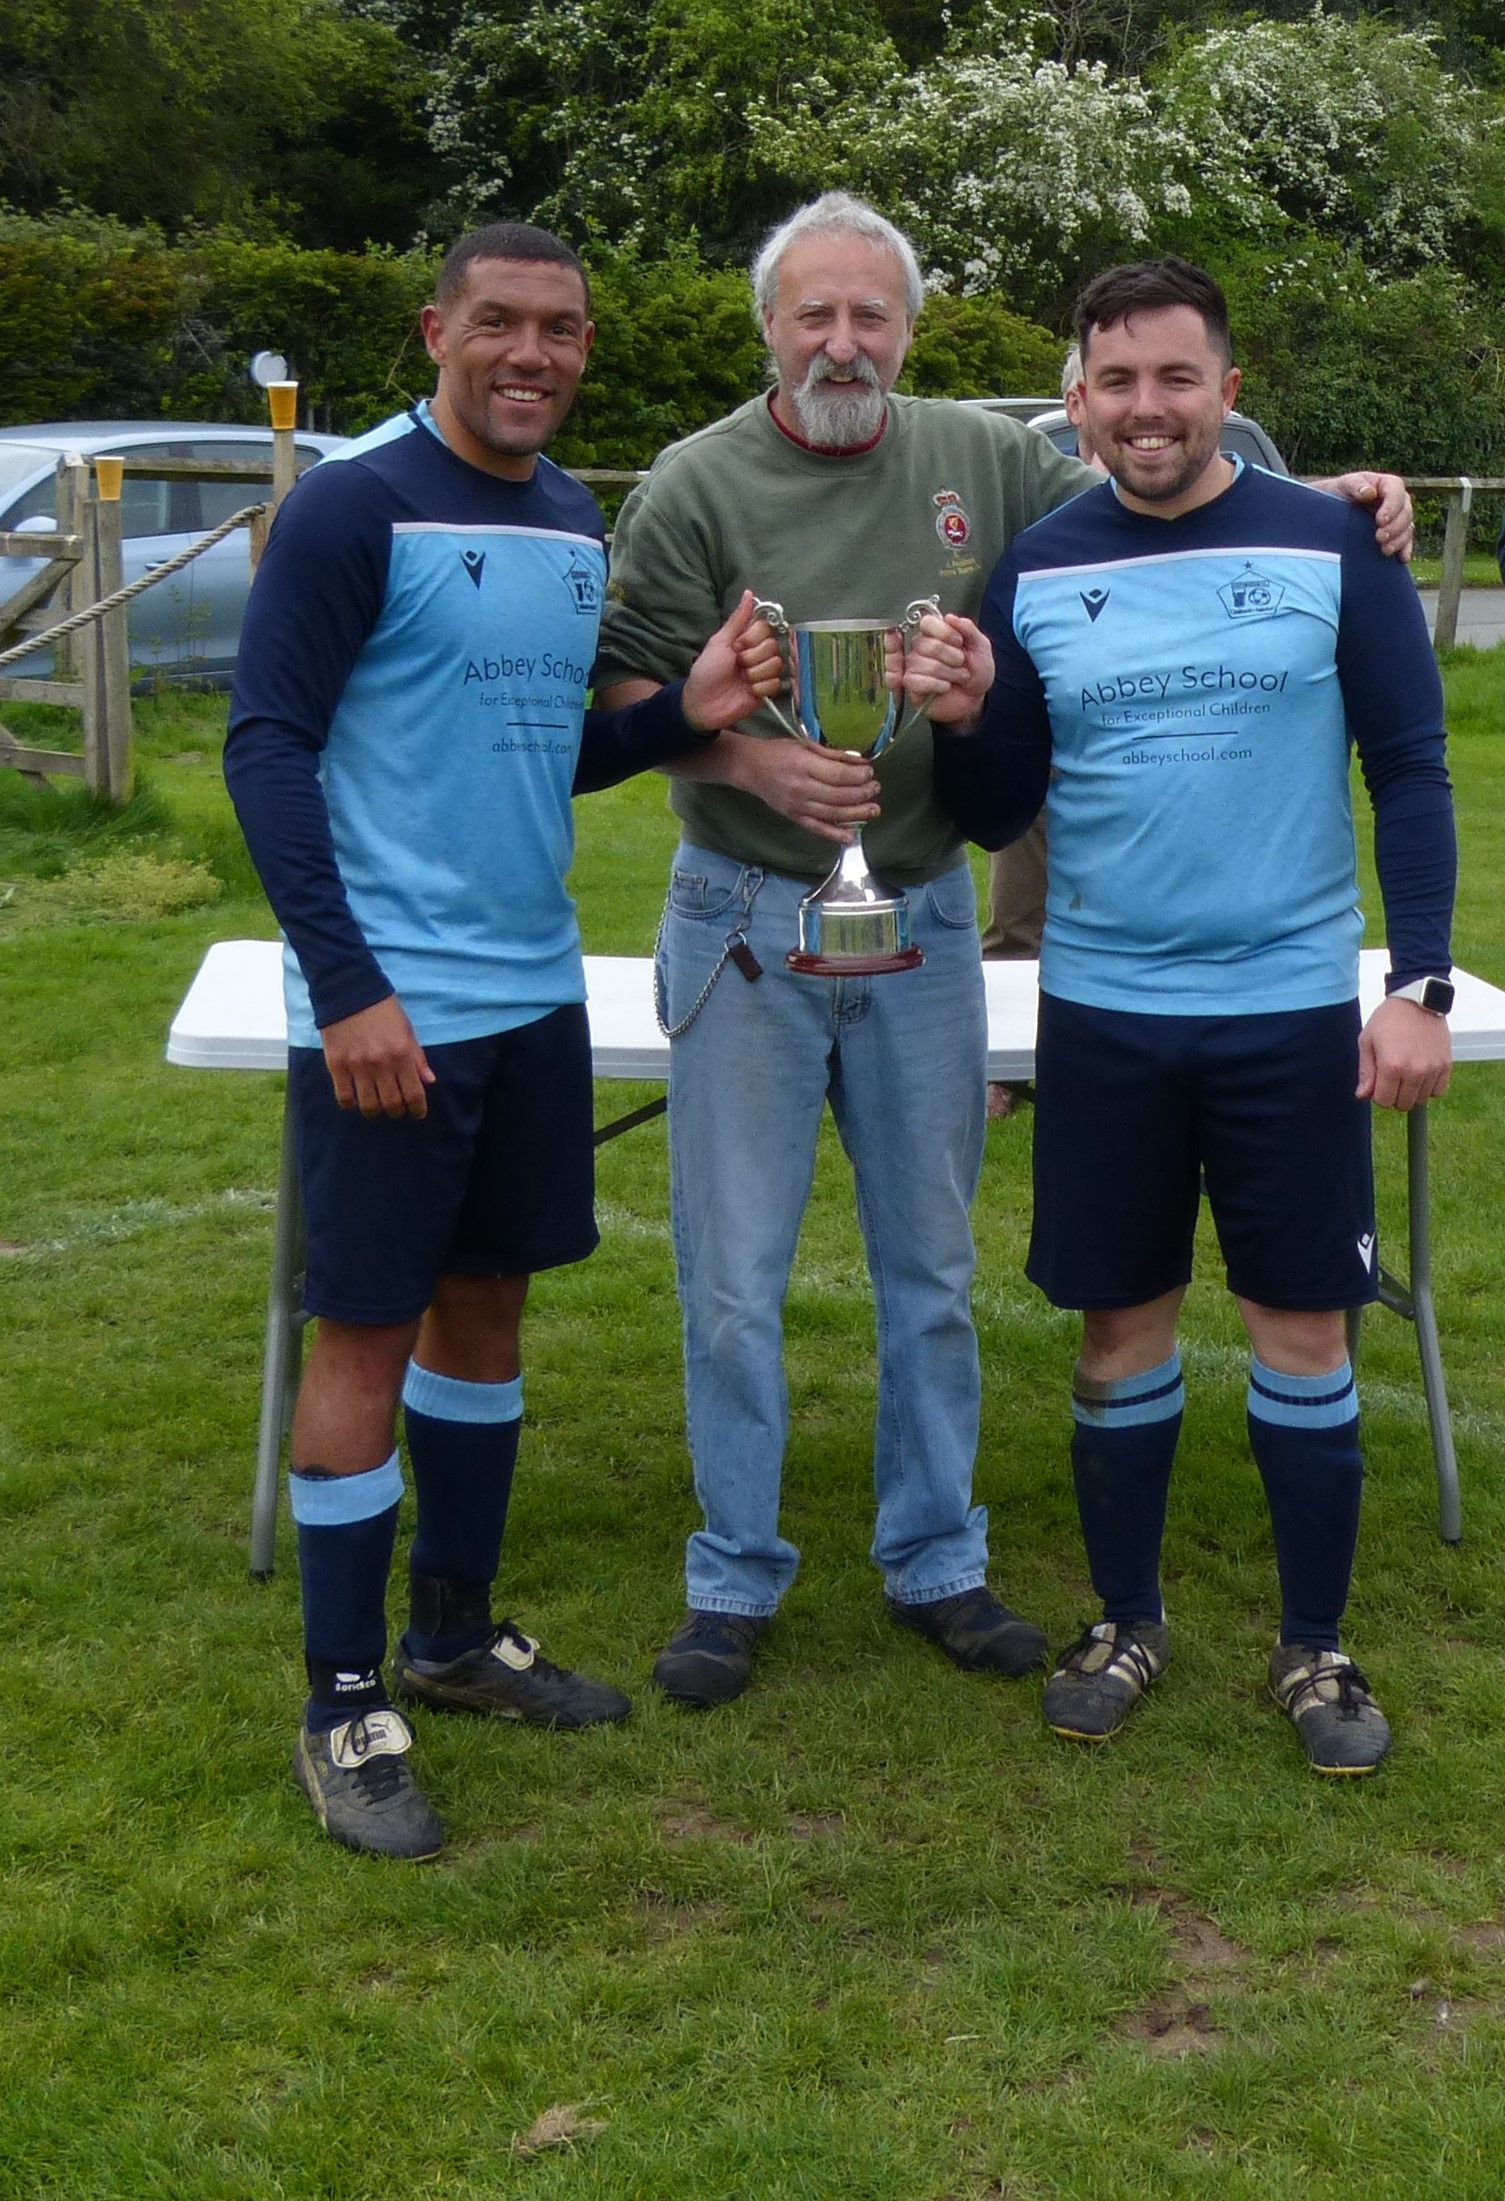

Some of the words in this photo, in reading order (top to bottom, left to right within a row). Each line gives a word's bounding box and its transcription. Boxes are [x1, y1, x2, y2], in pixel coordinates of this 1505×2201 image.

[464, 654, 536, 685] Abbey
[541, 652, 588, 685] Scho
[1080, 673, 1172, 711] Abbey
[1182, 665, 1289, 693] School
[1101, 712, 1121, 726] for
[1124, 705, 1206, 725] Exceptional
[1209, 702, 1271, 717] Children
[1121, 746, 1253, 766] abbeyschool.com
